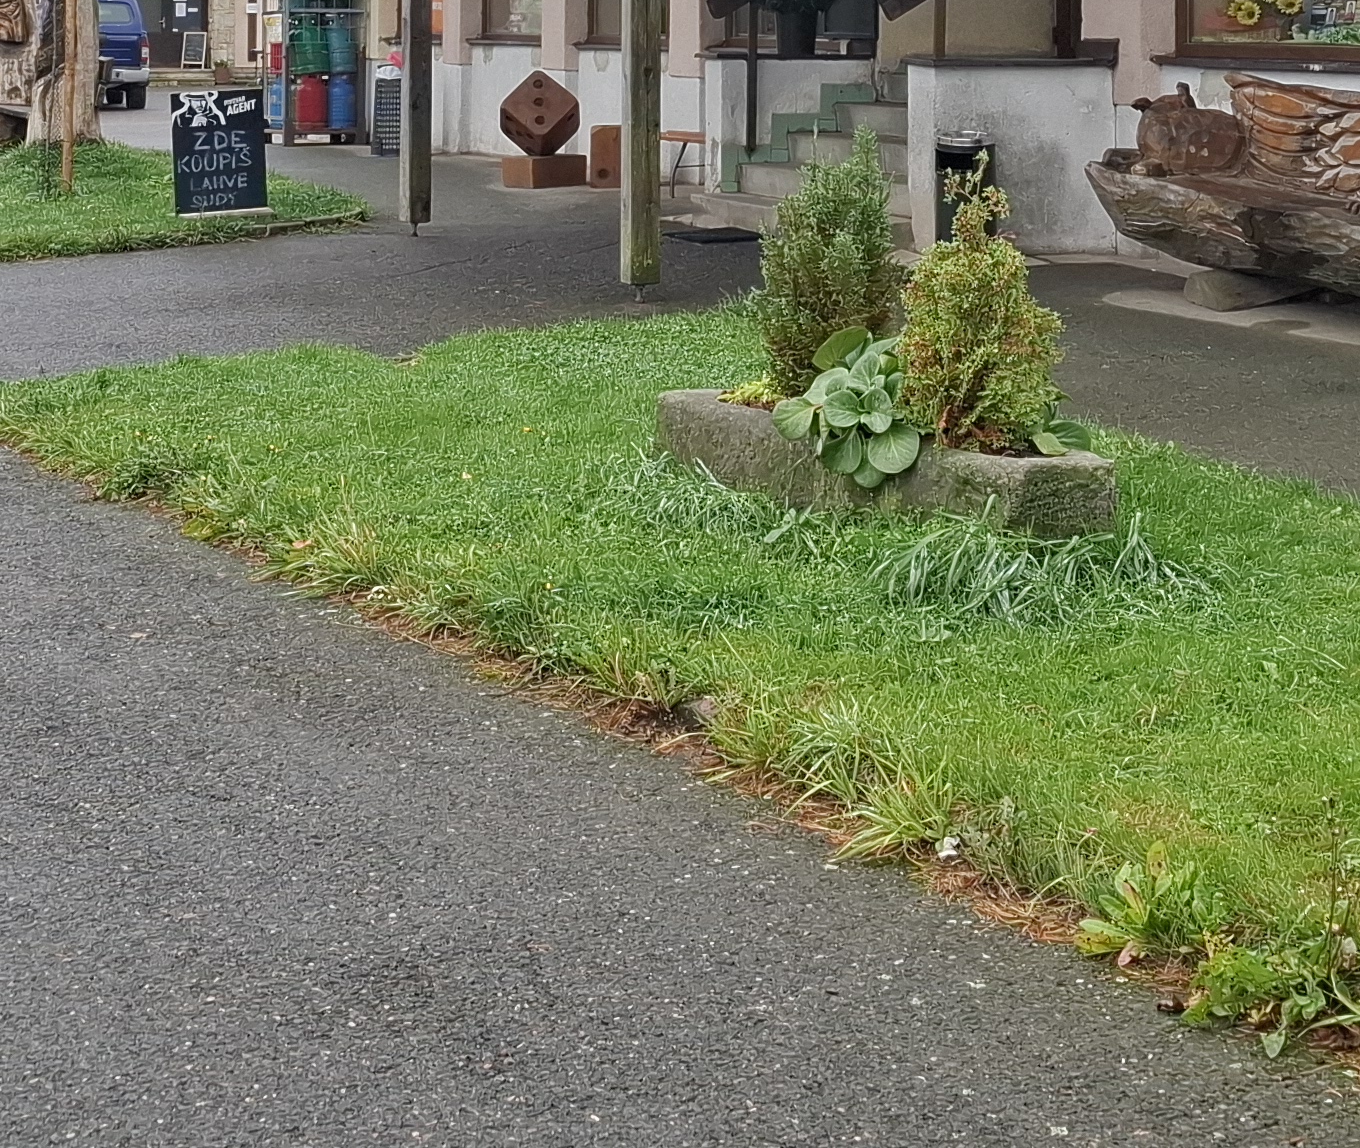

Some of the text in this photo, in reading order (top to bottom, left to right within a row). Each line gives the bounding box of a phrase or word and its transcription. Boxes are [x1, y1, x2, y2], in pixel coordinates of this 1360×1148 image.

[226, 98, 257, 117] AGENT
[193, 130, 248, 151] ZDE
[177, 146, 252, 174] KOUPÍŠ
[190, 172, 248, 191] LAHVE
